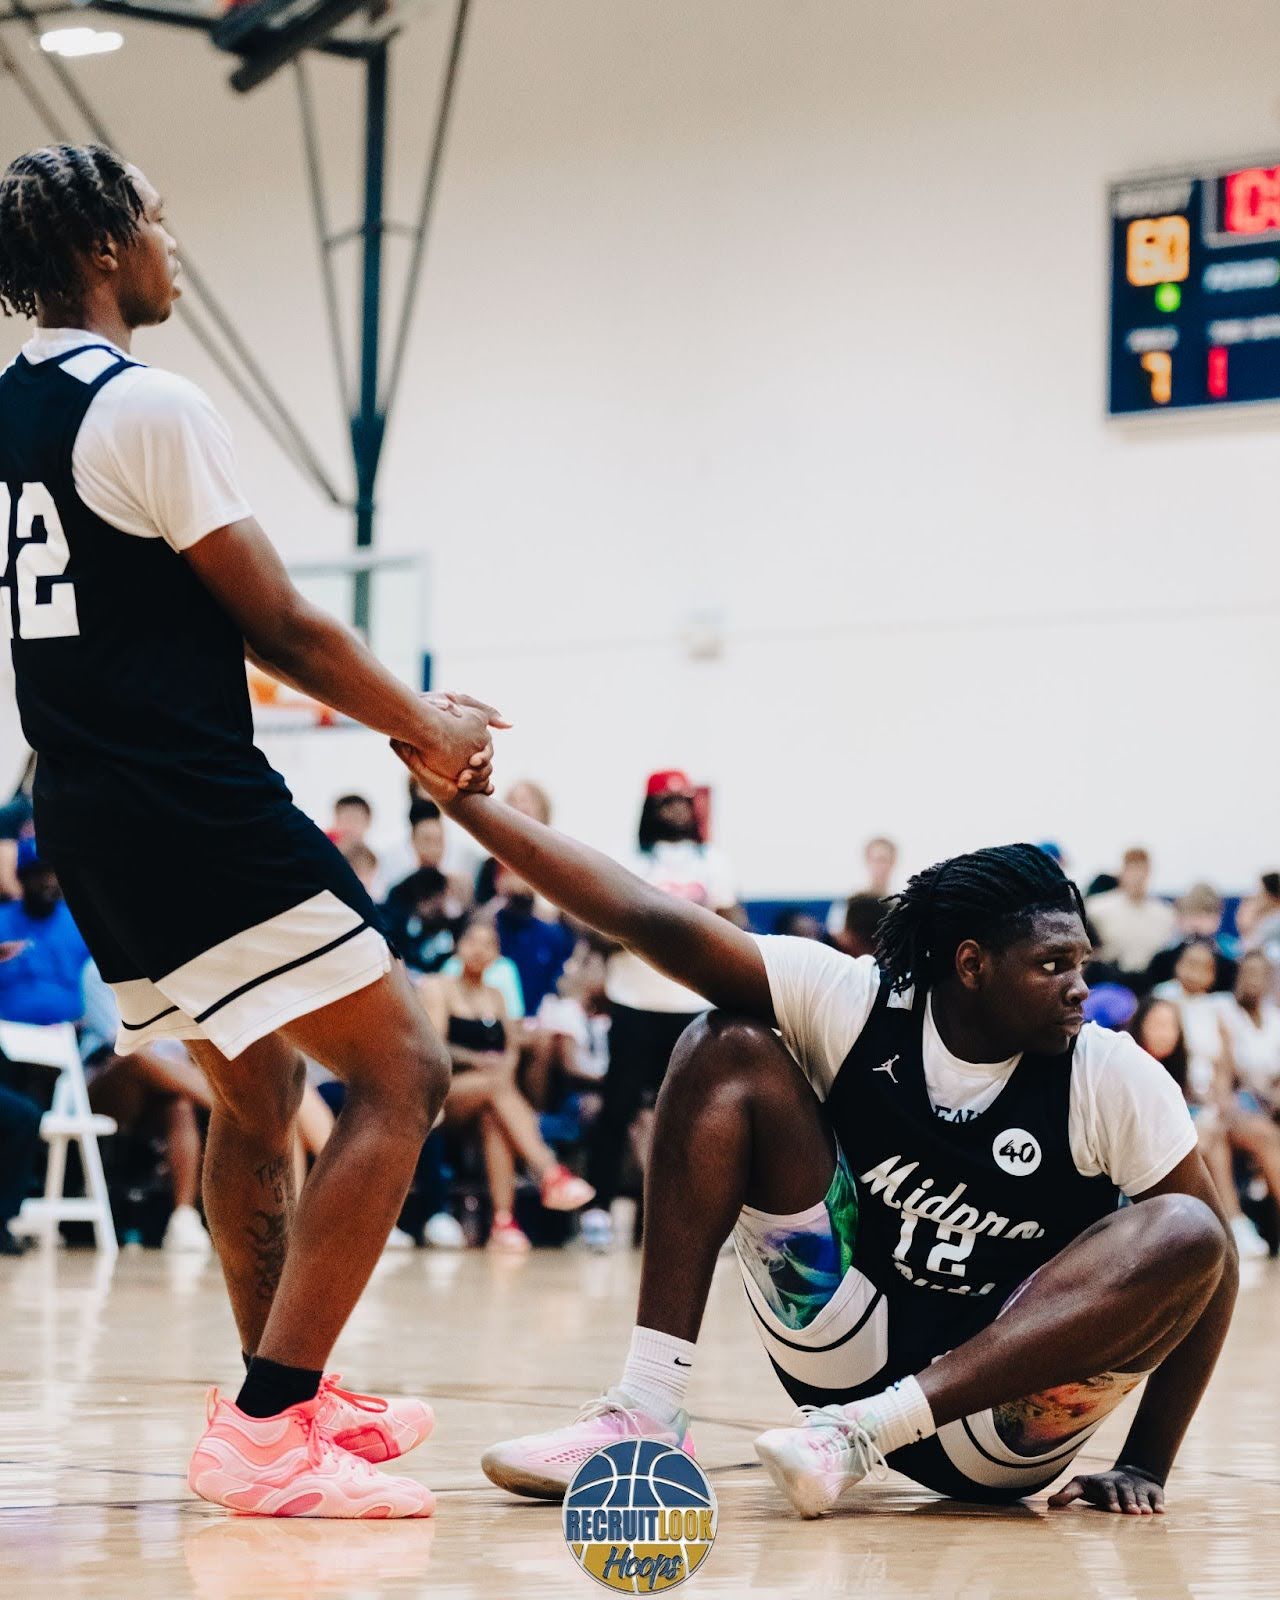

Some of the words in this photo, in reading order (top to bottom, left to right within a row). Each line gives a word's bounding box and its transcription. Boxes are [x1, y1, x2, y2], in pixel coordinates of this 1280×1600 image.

[1126, 215, 1190, 287] 60
[0, 482, 80, 640] 2
[999, 1140, 1036, 1163] 40
[892, 1211, 977, 1277] 12
